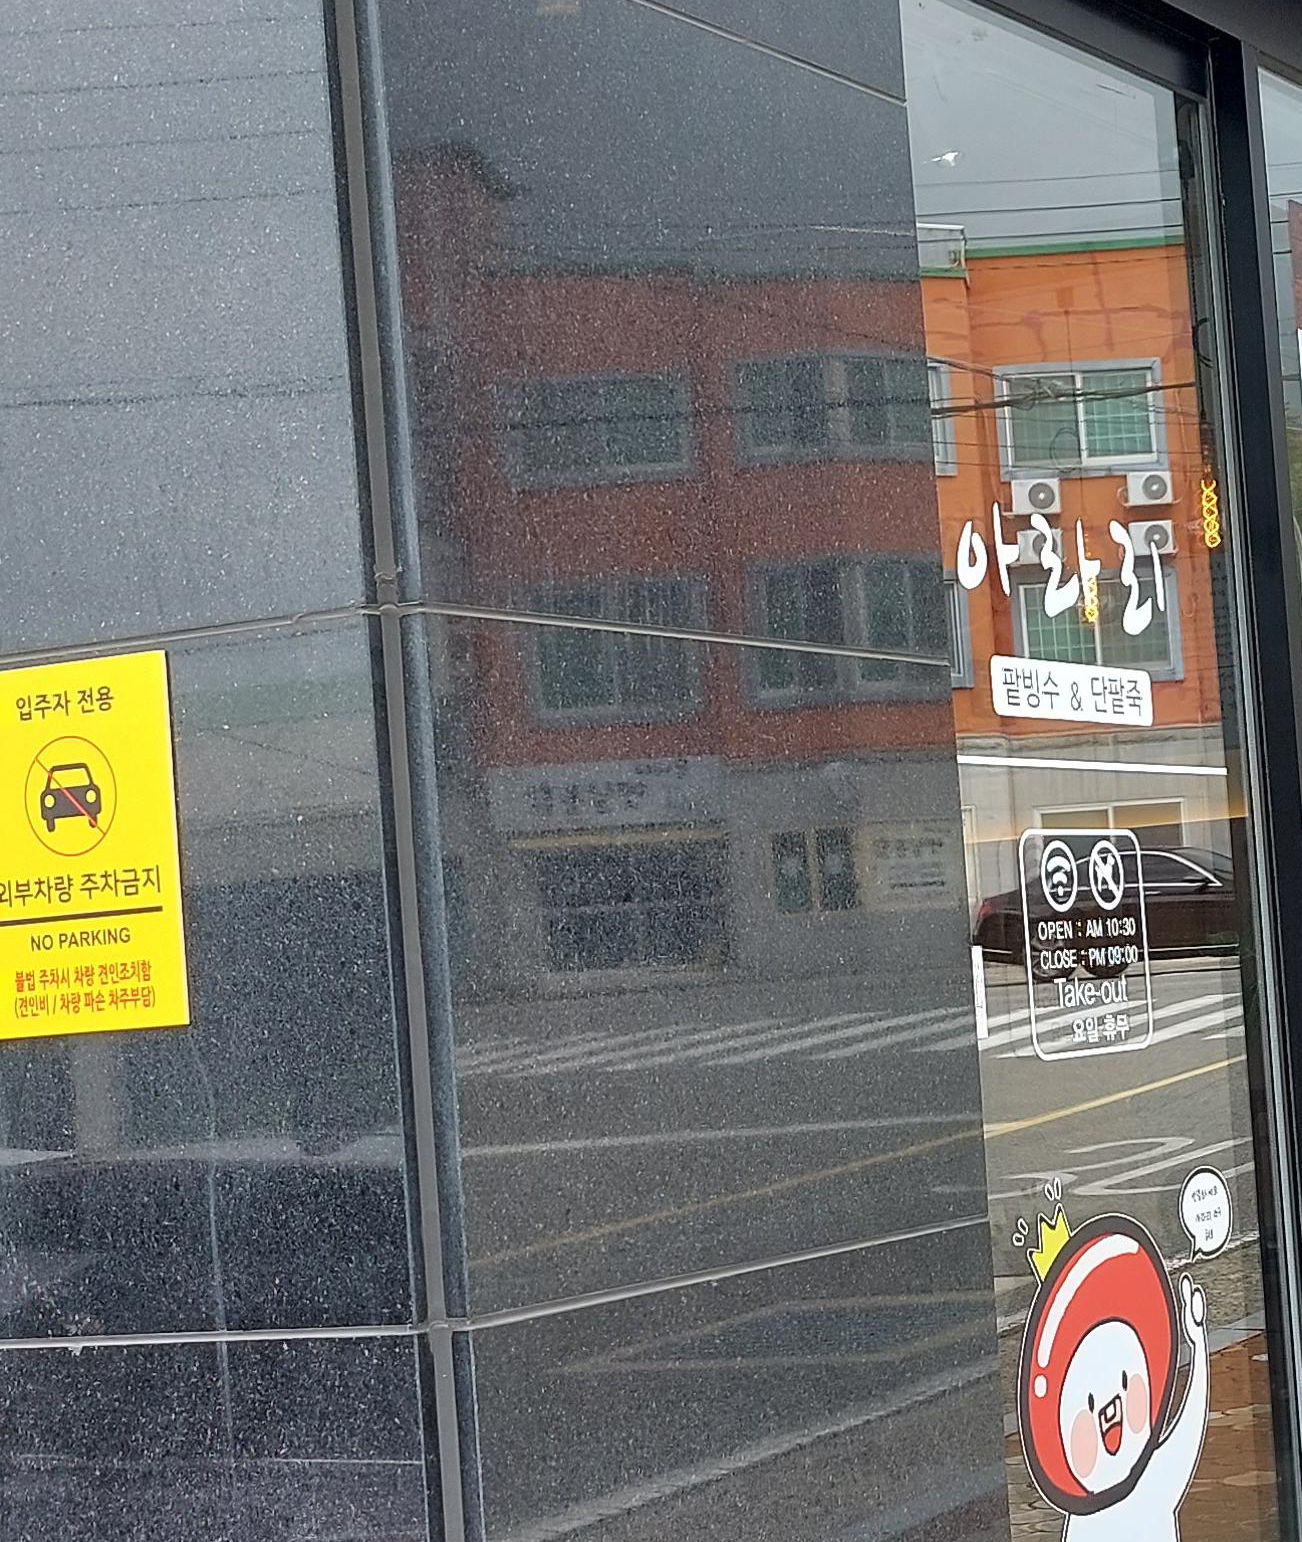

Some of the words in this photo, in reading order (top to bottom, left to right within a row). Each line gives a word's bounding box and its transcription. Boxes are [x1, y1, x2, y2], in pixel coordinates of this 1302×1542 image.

[956, 502, 1165, 635] 아라리
[15, 690, 70, 722] 입주자
[76, 685, 115, 715] 전용
[1002, 667, 1060, 709] 팥빙수
[1070, 681, 1083, 711] &
[1091, 676, 1143, 716] 단팥죽
[0, 874, 74, 907] 외부차량
[80, 864, 161, 899] 주차금지
[30, 934, 53, 952] NO
[59, 927, 131, 949] PARKING
[1038, 921, 1073, 940] OPEN
[1086, 918, 1103, 938] AM
[1106, 917, 1136, 937] 10:30
[15, 970, 35, 992] 불법
[39, 967, 70, 990] 주차시
[74, 964, 95, 987] 차량
[98, 959, 152, 985] 견인조치함
[1040, 949, 1077, 970] CLOSE
[1089, 948, 1105, 967] PM
[60, 991, 81, 1014] 차량
[84, 990, 105, 1012] 파손
[1054, 974, 1128, 1008] Take-out
[1072, 1017, 1100, 1042] 요일
[1102, 1013, 1130, 1041] 휴무
